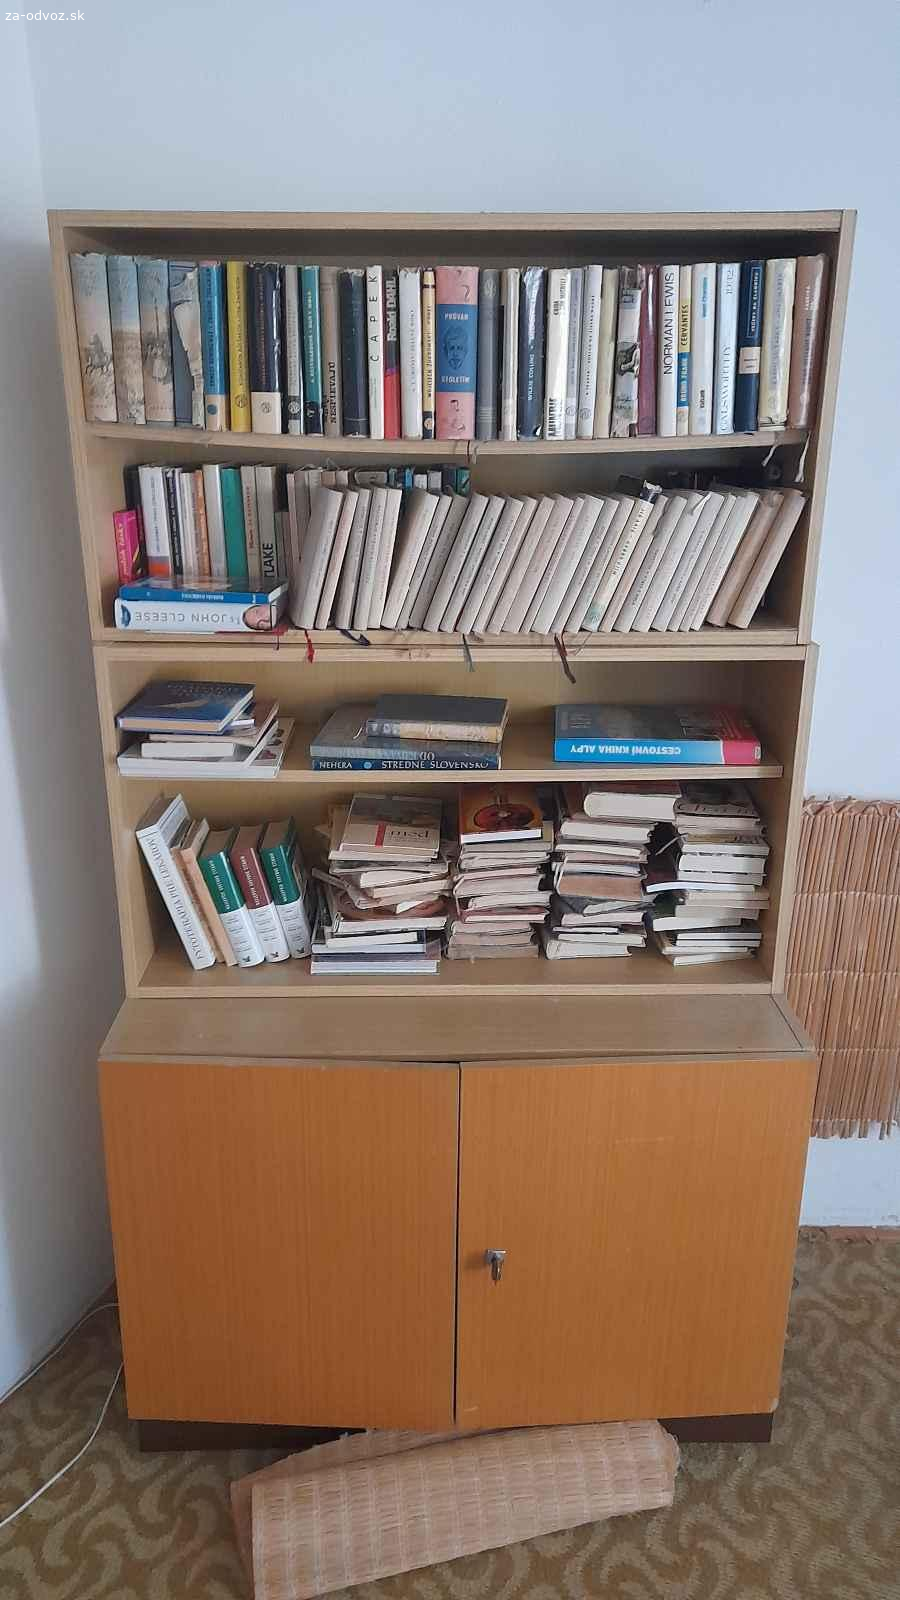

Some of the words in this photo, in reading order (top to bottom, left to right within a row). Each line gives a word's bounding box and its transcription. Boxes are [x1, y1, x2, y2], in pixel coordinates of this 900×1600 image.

[385, 276, 397, 312] DAHL
[664, 272, 675, 316] LEWIS
[386, 315, 397, 342] Roald
[680, 304, 689, 346] CERVANTES
[663, 319, 673, 375] NORMAN
[136, 611, 185, 622] CLEESE
[191, 612, 226, 624] JOHN
[570, 744, 595, 753] ALPY
[598, 745, 629, 754] KNIHA
[632, 745, 681, 756] CESTOVNÍ
[320, 761, 352, 769] NEHERA
[430, 761, 489, 769] SLOVENSKO
